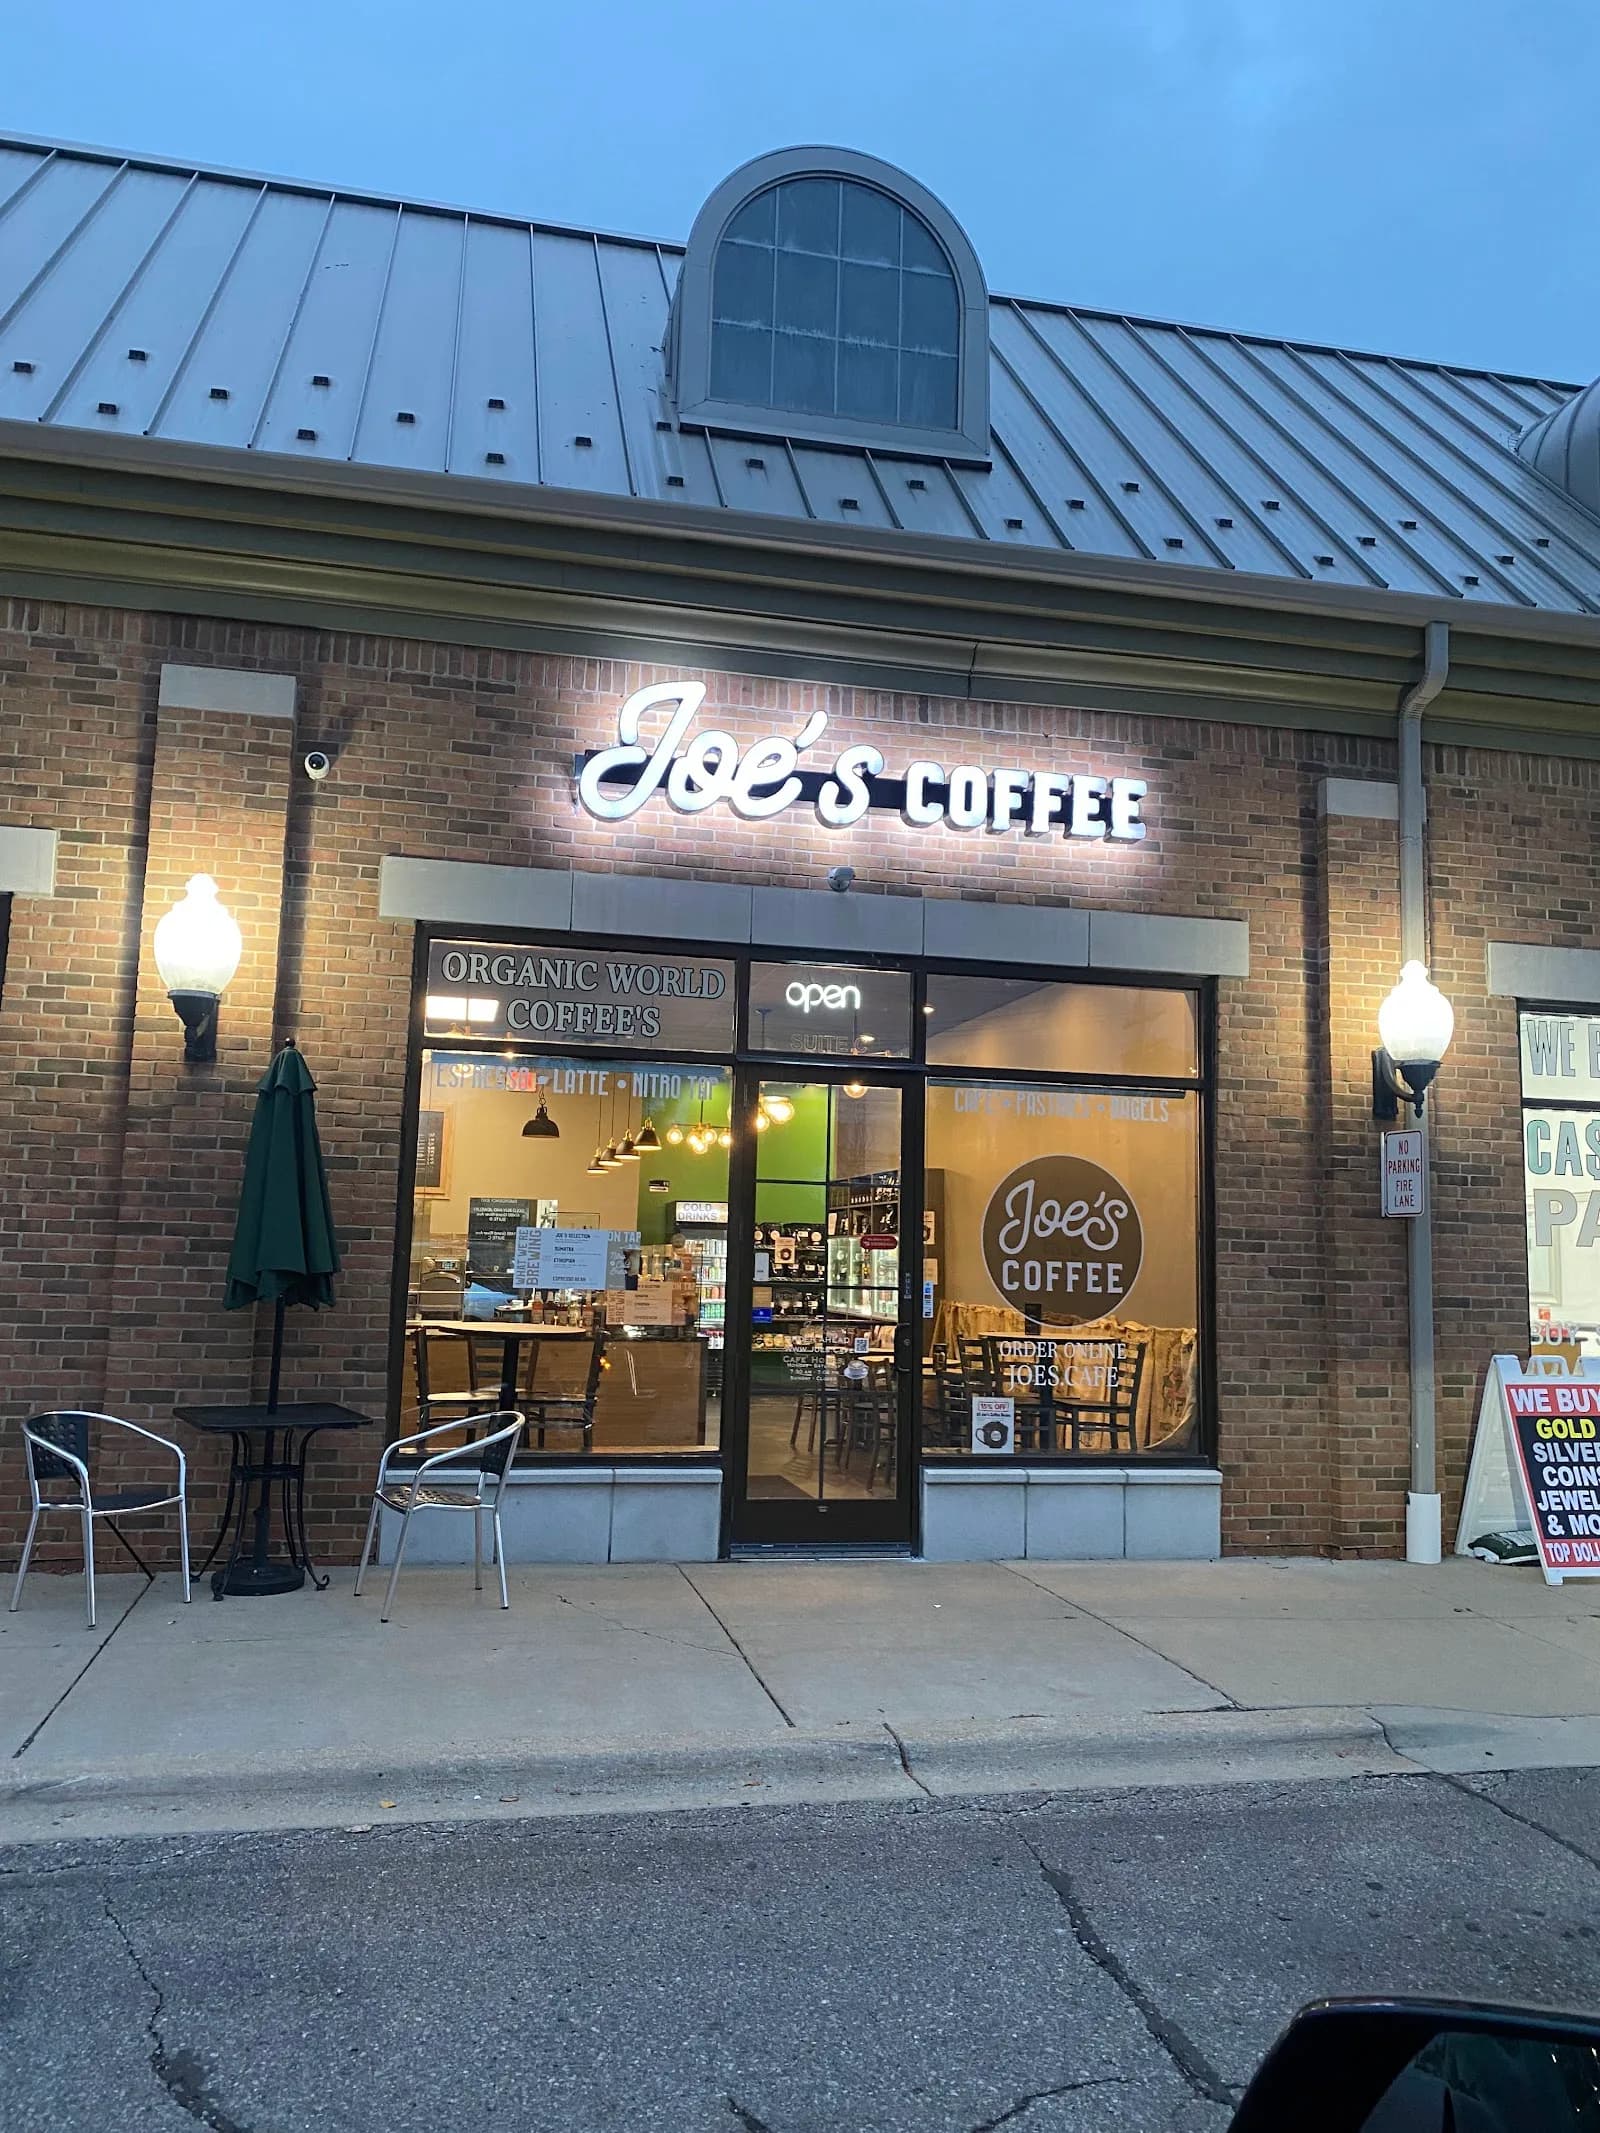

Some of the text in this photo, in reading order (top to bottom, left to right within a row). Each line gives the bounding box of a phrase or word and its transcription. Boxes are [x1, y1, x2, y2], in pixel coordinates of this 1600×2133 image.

[579, 680, 1148, 844] Joe's COFFEE
[442, 951, 725, 999] ORGANIC WORLD
[785, 982, 861, 1014] open
[507, 999, 661, 1037] COFFEE'S
[790, 1033, 849, 1052] SUITE
[1527, 1019, 1576, 1077] WE
[553, 1069, 609, 1096] LATTE
[632, 1072, 681, 1099] NITRO
[1398, 1140, 1409, 1155] NO
[1388, 1158, 1420, 1175] PARKING
[1396, 1180, 1413, 1192] FIRE
[683, 1203, 712, 1212] COLD
[1394, 1195, 1415, 1208] LANE
[678, 1212, 718, 1221] DRINKS
[998, 1179, 1128, 1255] Joe's
[526, 1230, 542, 1286] BREWING
[515, 1259, 526, 1285] WHAT
[1002, 1259, 1123, 1294] COFFEE
[1000, 1340, 1127, 1361] ORDER ONLINE
[1008, 1364, 1120, 1392] JOES.CAFE
[1510, 1388, 1600, 1413] WE BUY
[1536, 1418, 1596, 1439] GOLD
[1547, 1514, 1565, 1536] &
[1545, 1542, 1572, 1563] TOP
